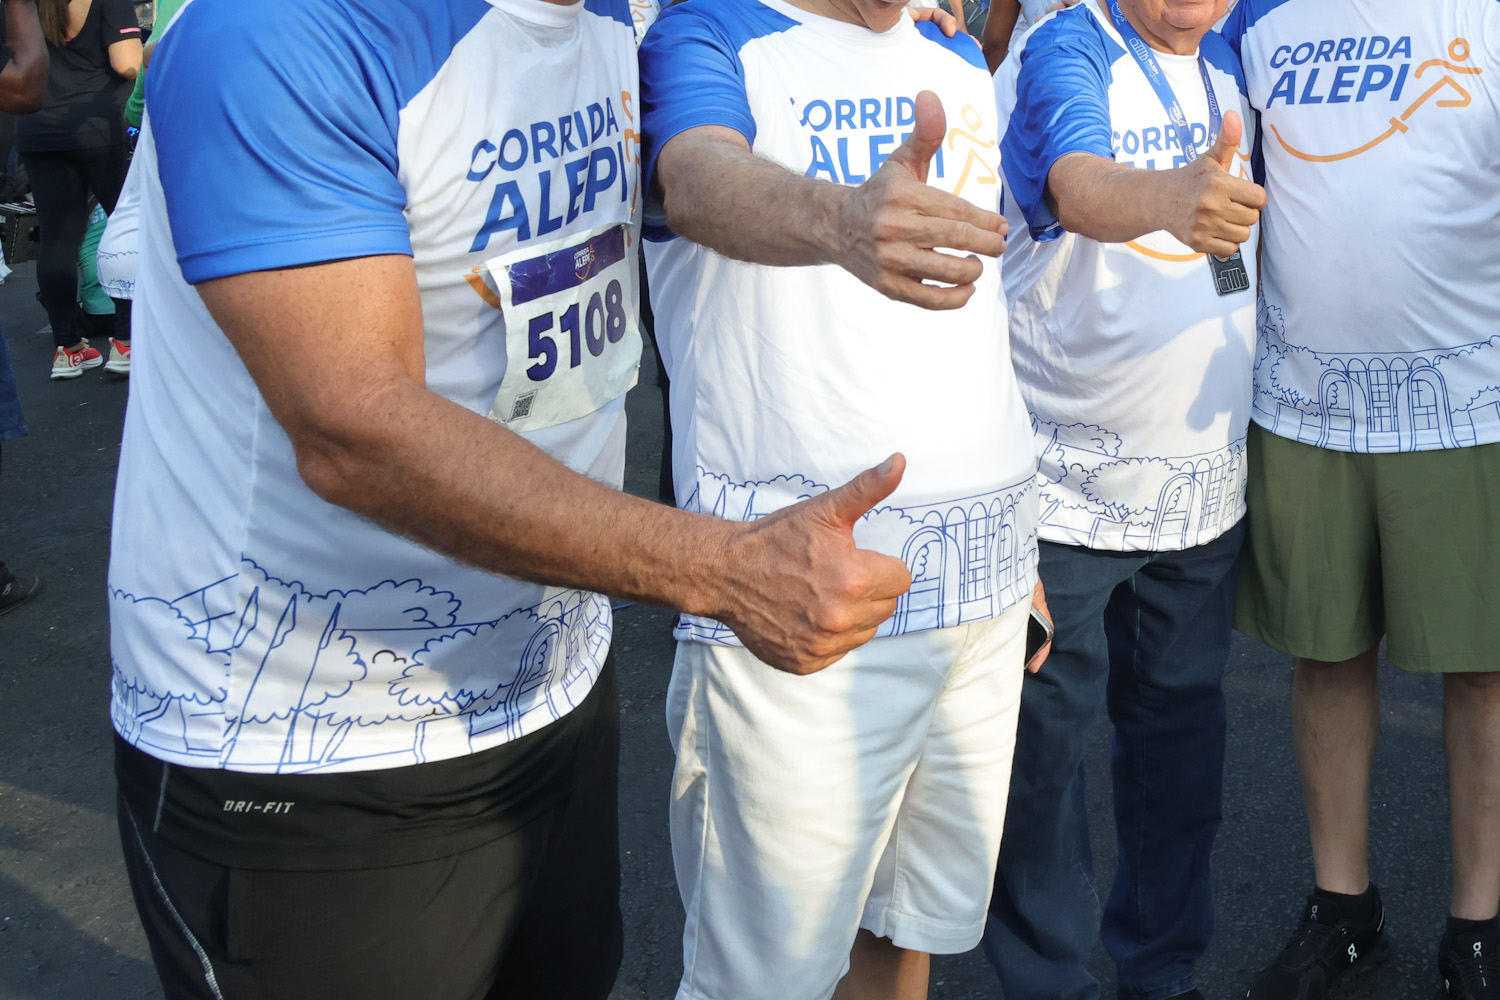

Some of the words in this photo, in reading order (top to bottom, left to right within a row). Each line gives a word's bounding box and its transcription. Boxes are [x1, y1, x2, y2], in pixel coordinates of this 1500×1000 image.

[1269, 36, 1412, 69] CORRIDA
[1265, 63, 1411, 110] ALEPI
[790, 96, 916, 132] ORRID
[465, 97, 619, 182] CORRIDA
[805, 132, 945, 184] ALEI
[468, 141, 628, 254] ALEPI
[526, 279, 627, 382] 5108
[223, 799, 296, 815] DRI-FIT
